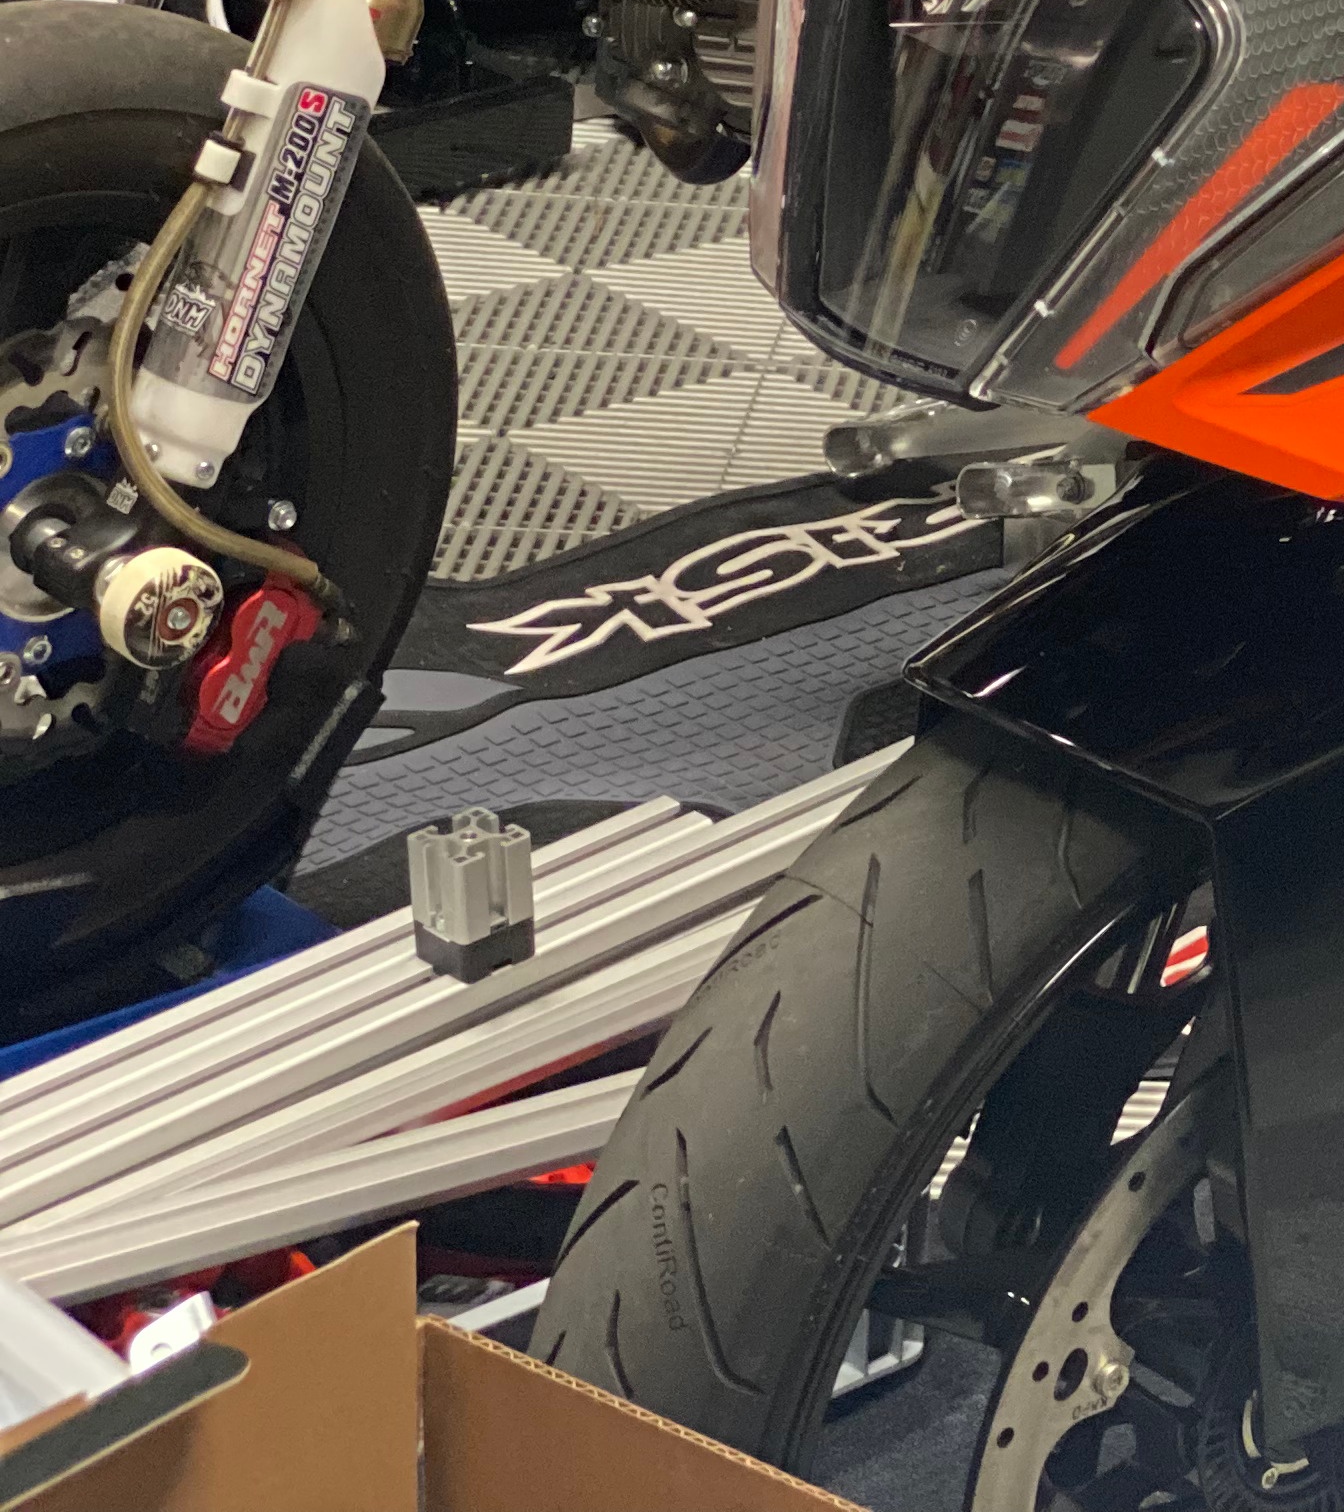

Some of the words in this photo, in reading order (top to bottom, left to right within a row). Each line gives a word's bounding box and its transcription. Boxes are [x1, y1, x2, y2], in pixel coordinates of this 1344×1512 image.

[208, 199, 287, 382] HORNET
[231, 96, 356, 396] DYNAMOUNT
[650, 1182, 689, 1331] ContiRoad
